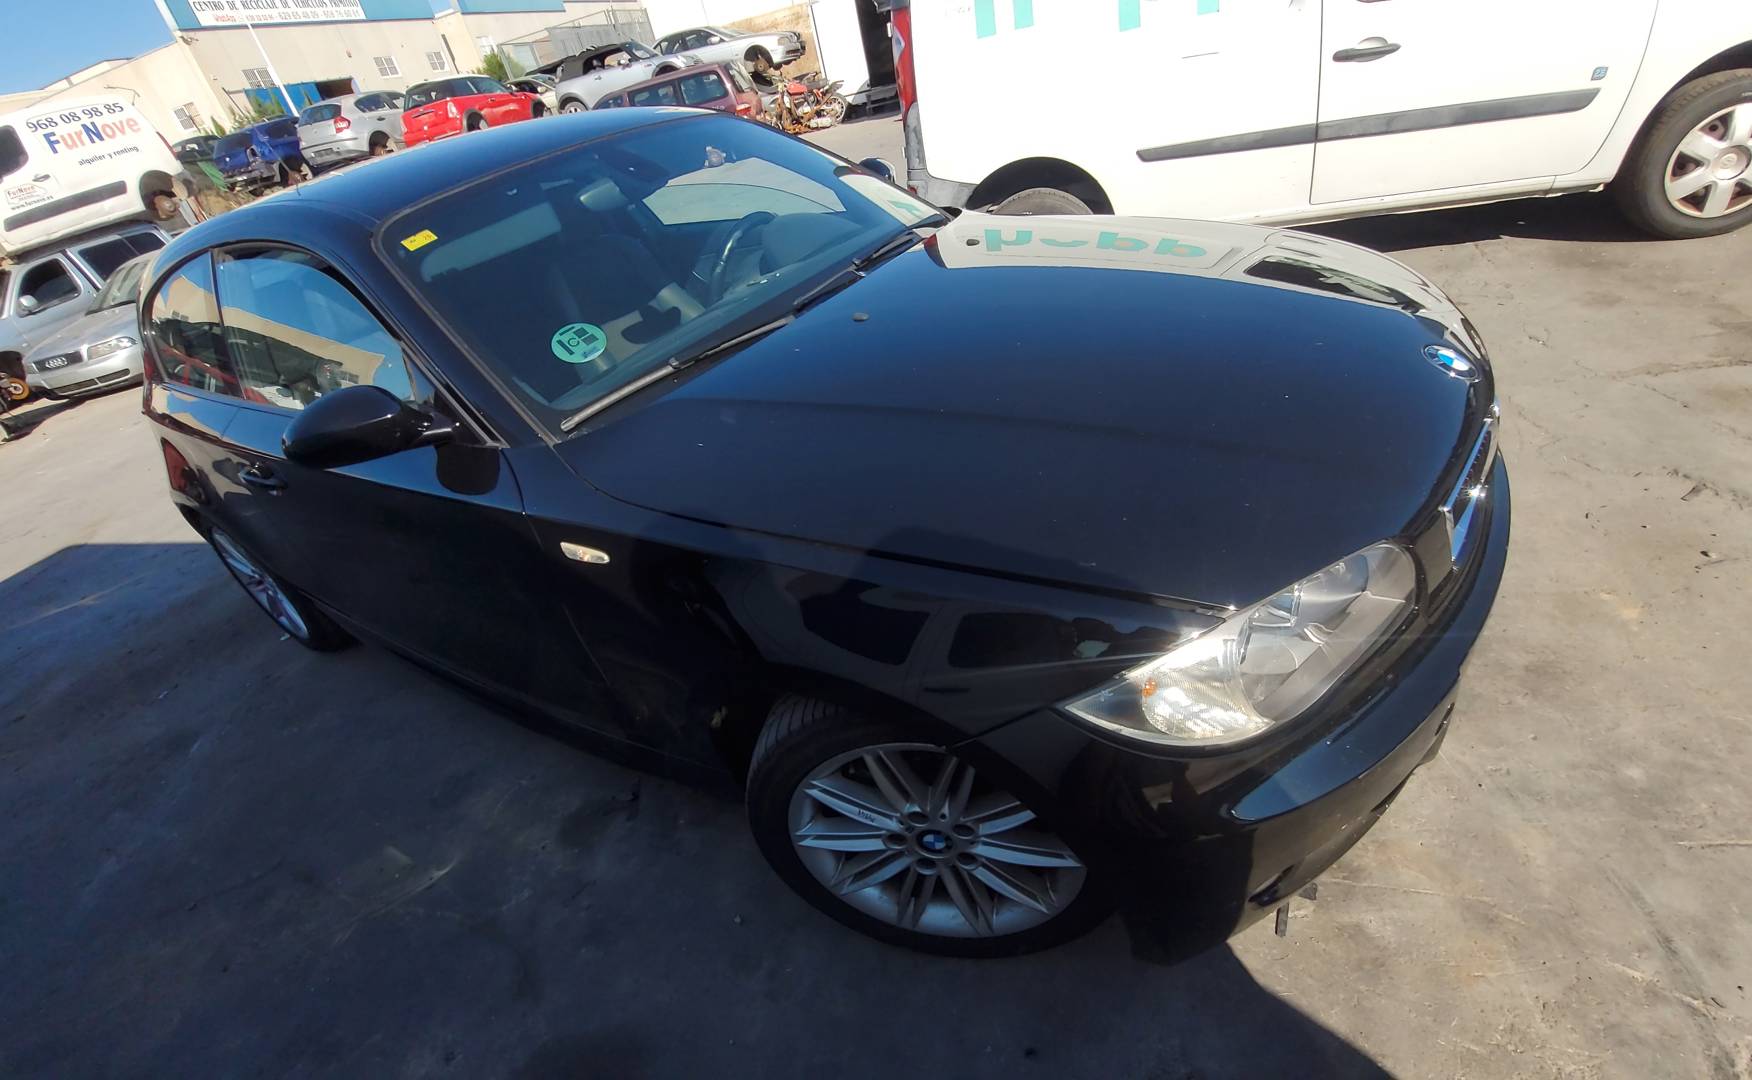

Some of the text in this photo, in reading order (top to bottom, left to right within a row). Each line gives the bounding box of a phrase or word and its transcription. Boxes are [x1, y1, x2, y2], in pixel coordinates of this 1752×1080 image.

[193, 1, 225, 11] CENTRO
[226, 0, 239, 10] DE
[26, 102, 124, 133] 968 08 98 85
[43, 117, 141, 154] FurNove
[78, 154, 106, 166] alquiler
[113, 146, 139, 156] renting
